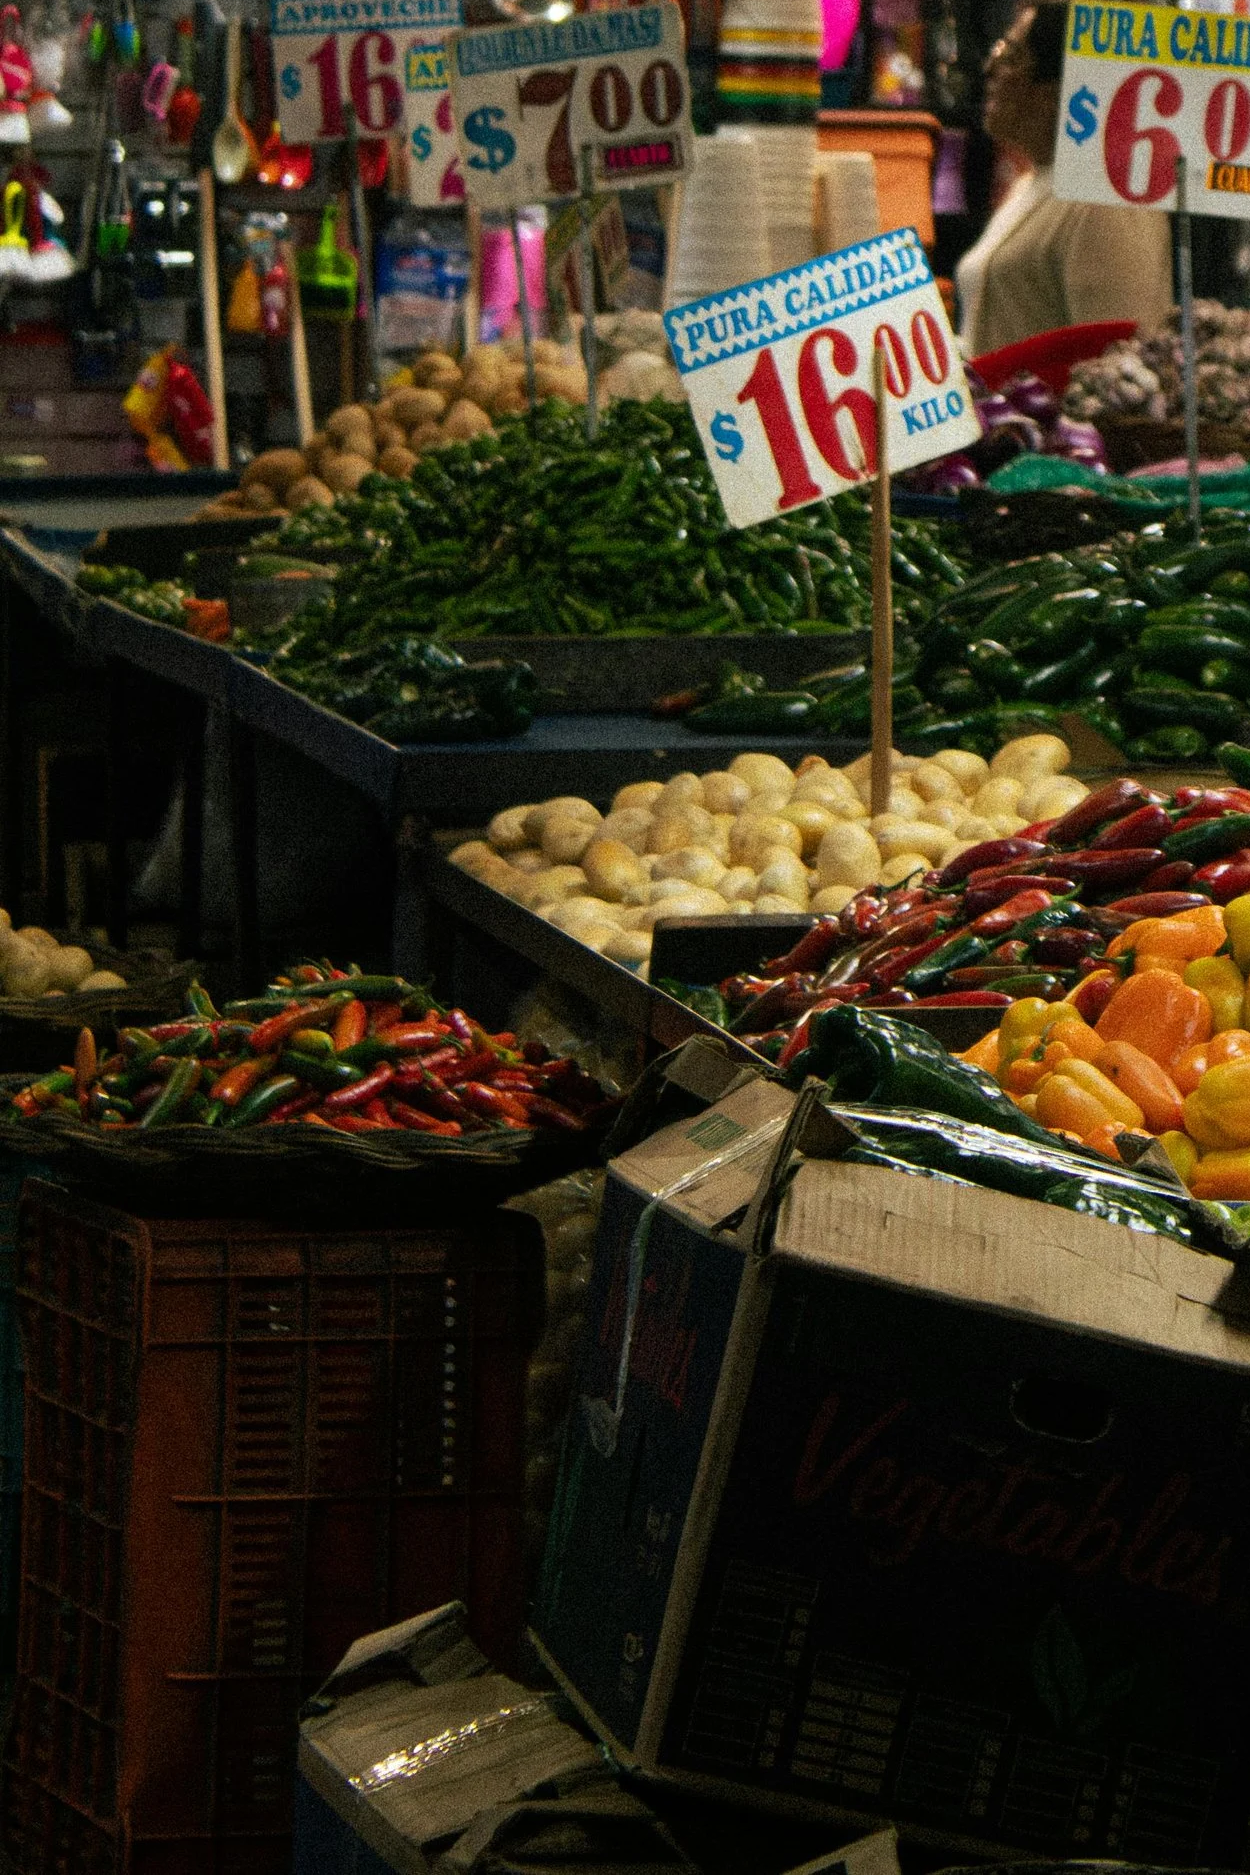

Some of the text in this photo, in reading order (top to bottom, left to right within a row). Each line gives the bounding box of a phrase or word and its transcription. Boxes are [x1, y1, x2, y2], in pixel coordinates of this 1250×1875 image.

[1071, 5, 1160, 60] PURA
[685, 245, 919, 352] PURA CALIDAD
[901, 389, 965, 436] KILO
[791, 1390, 1233, 1607] Vegetables
